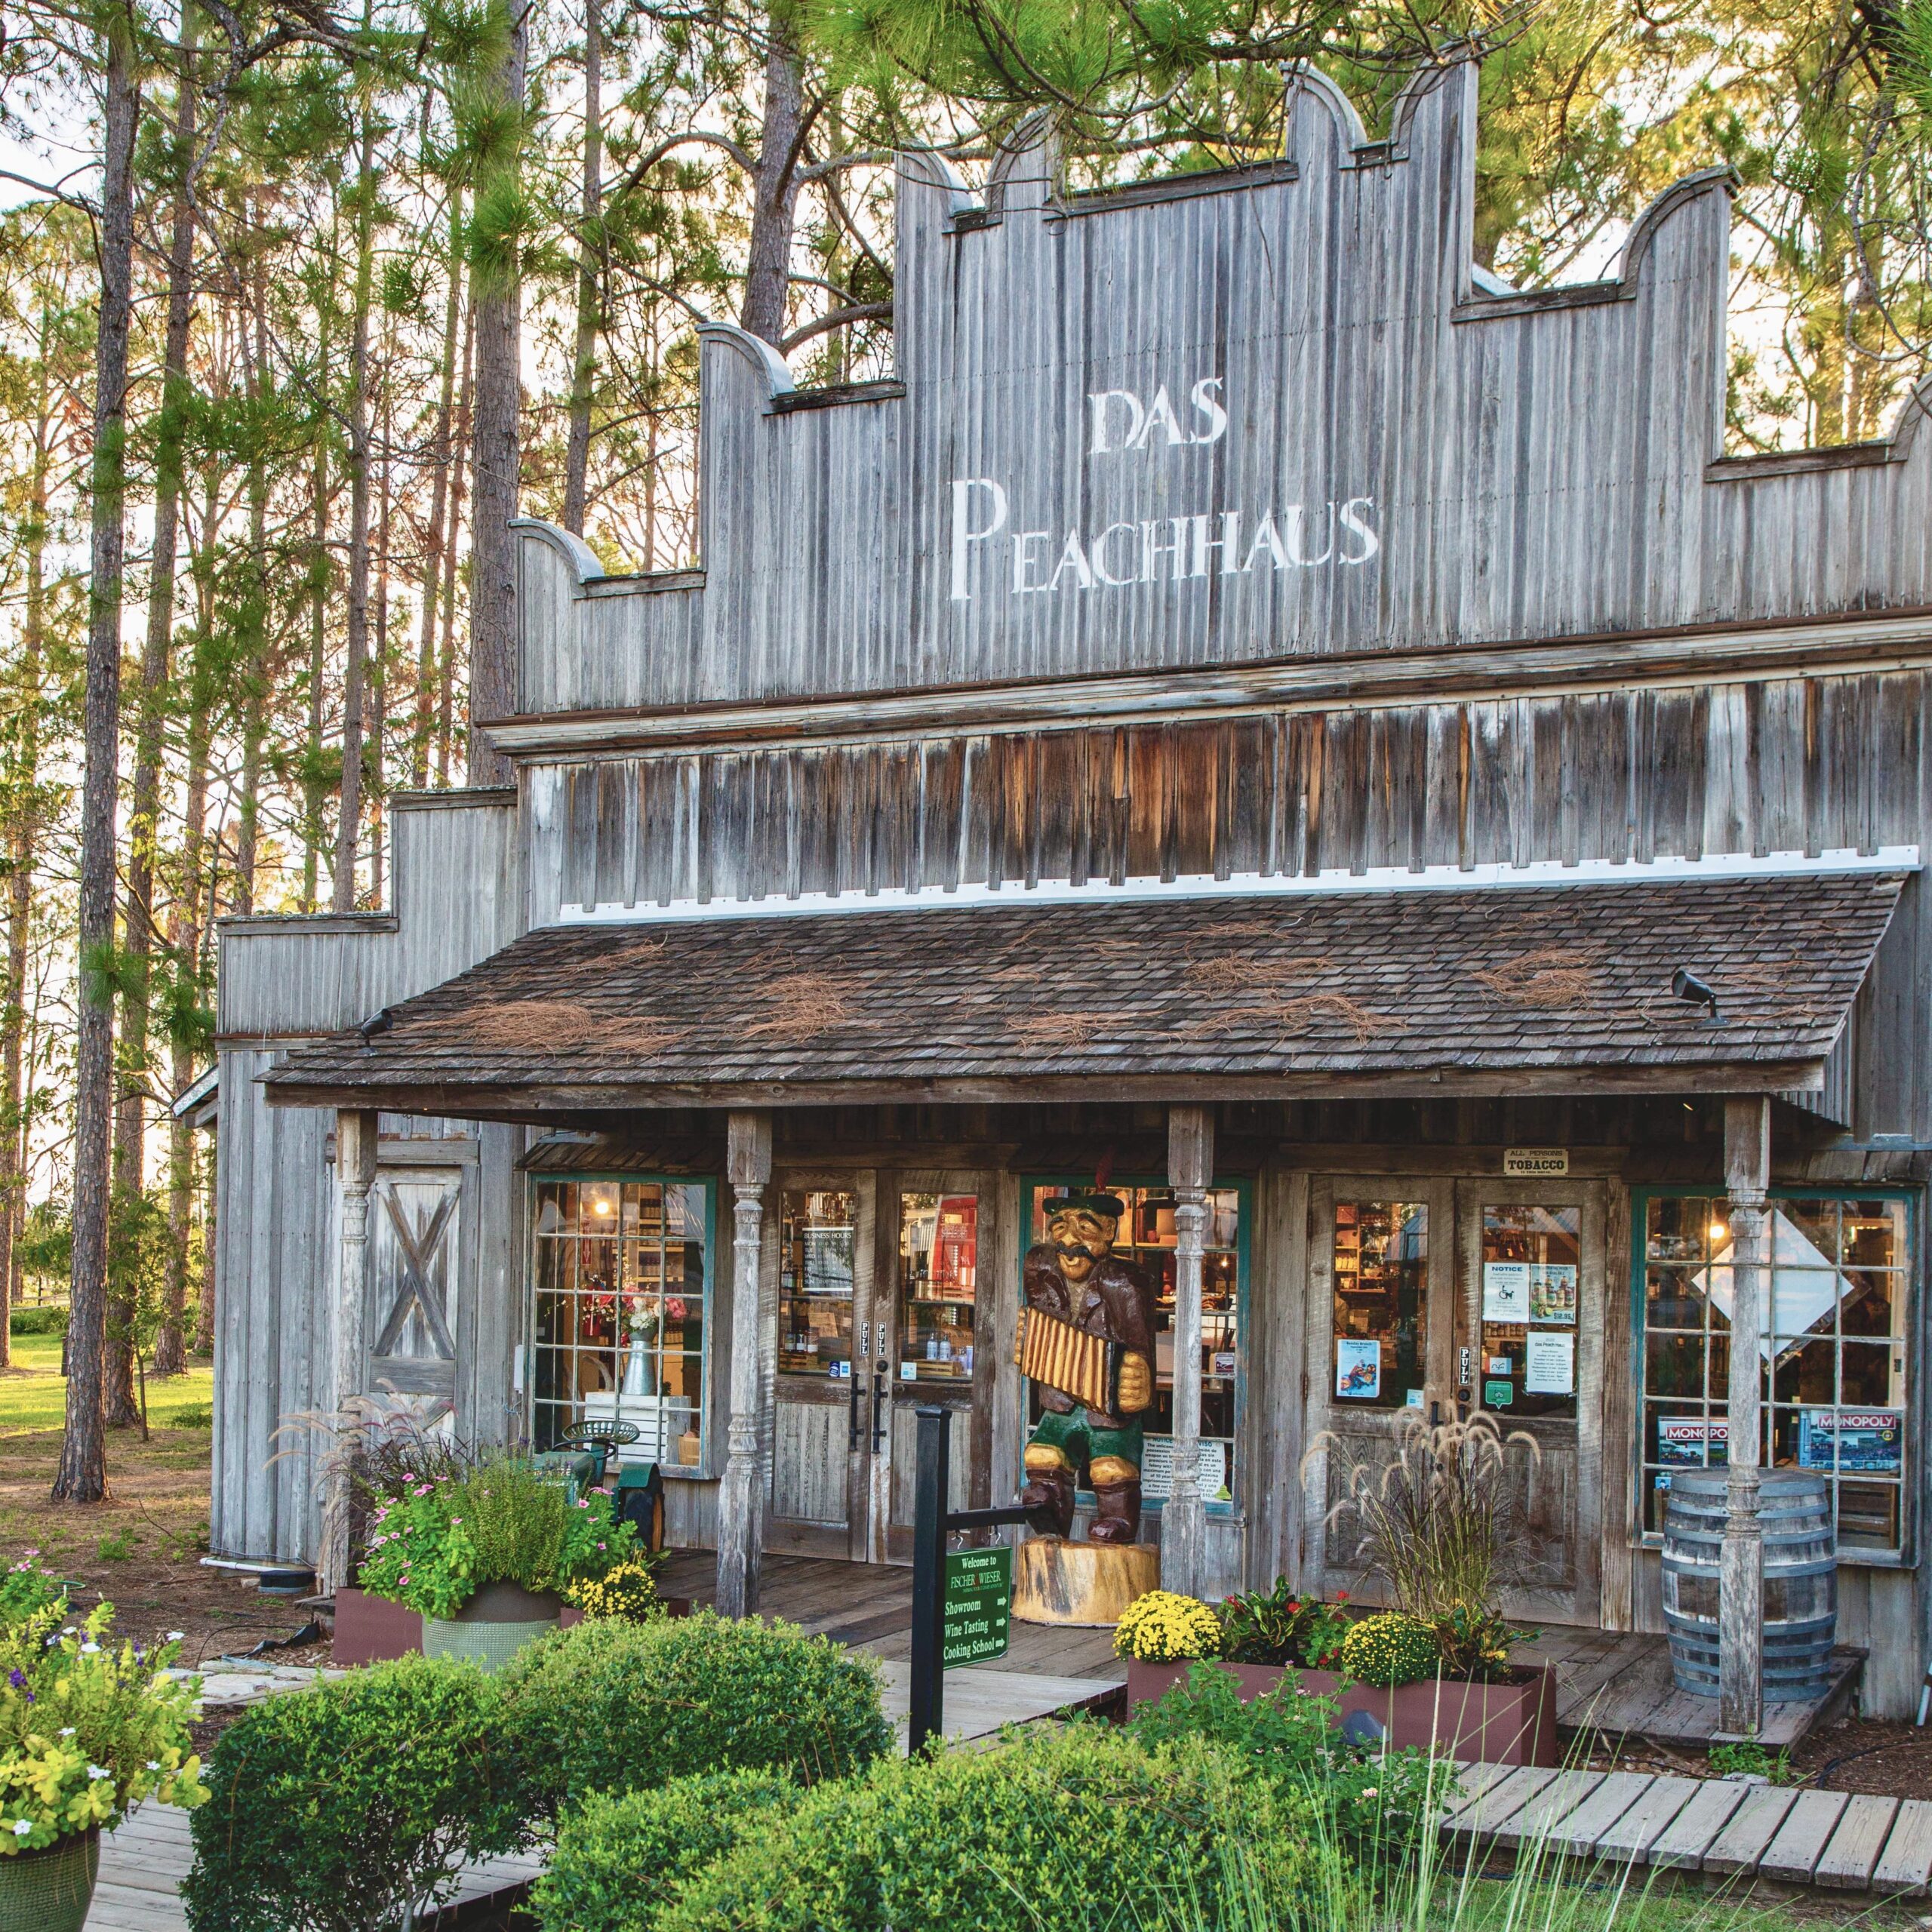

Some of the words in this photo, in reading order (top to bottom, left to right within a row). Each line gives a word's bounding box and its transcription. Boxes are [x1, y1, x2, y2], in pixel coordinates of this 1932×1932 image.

[1087, 376, 1228, 454] DAS
[946, 478, 1380, 601] PEACHHAUS
[1508, 1159, 1564, 1170] TOBACCO
[961, 1556, 989, 1570] Welcome
[990, 1555, 997, 1566] to
[951, 1574, 976, 1589] FISCHER
[978, 1570, 1001, 1585] WIESER
[945, 1600, 981, 1616] Showroom
[945, 1623, 962, 1638] Wine
[963, 1619, 989, 1635] Tasting
[943, 1644, 971, 1660] Cooking
[972, 1636, 995, 1654] School
